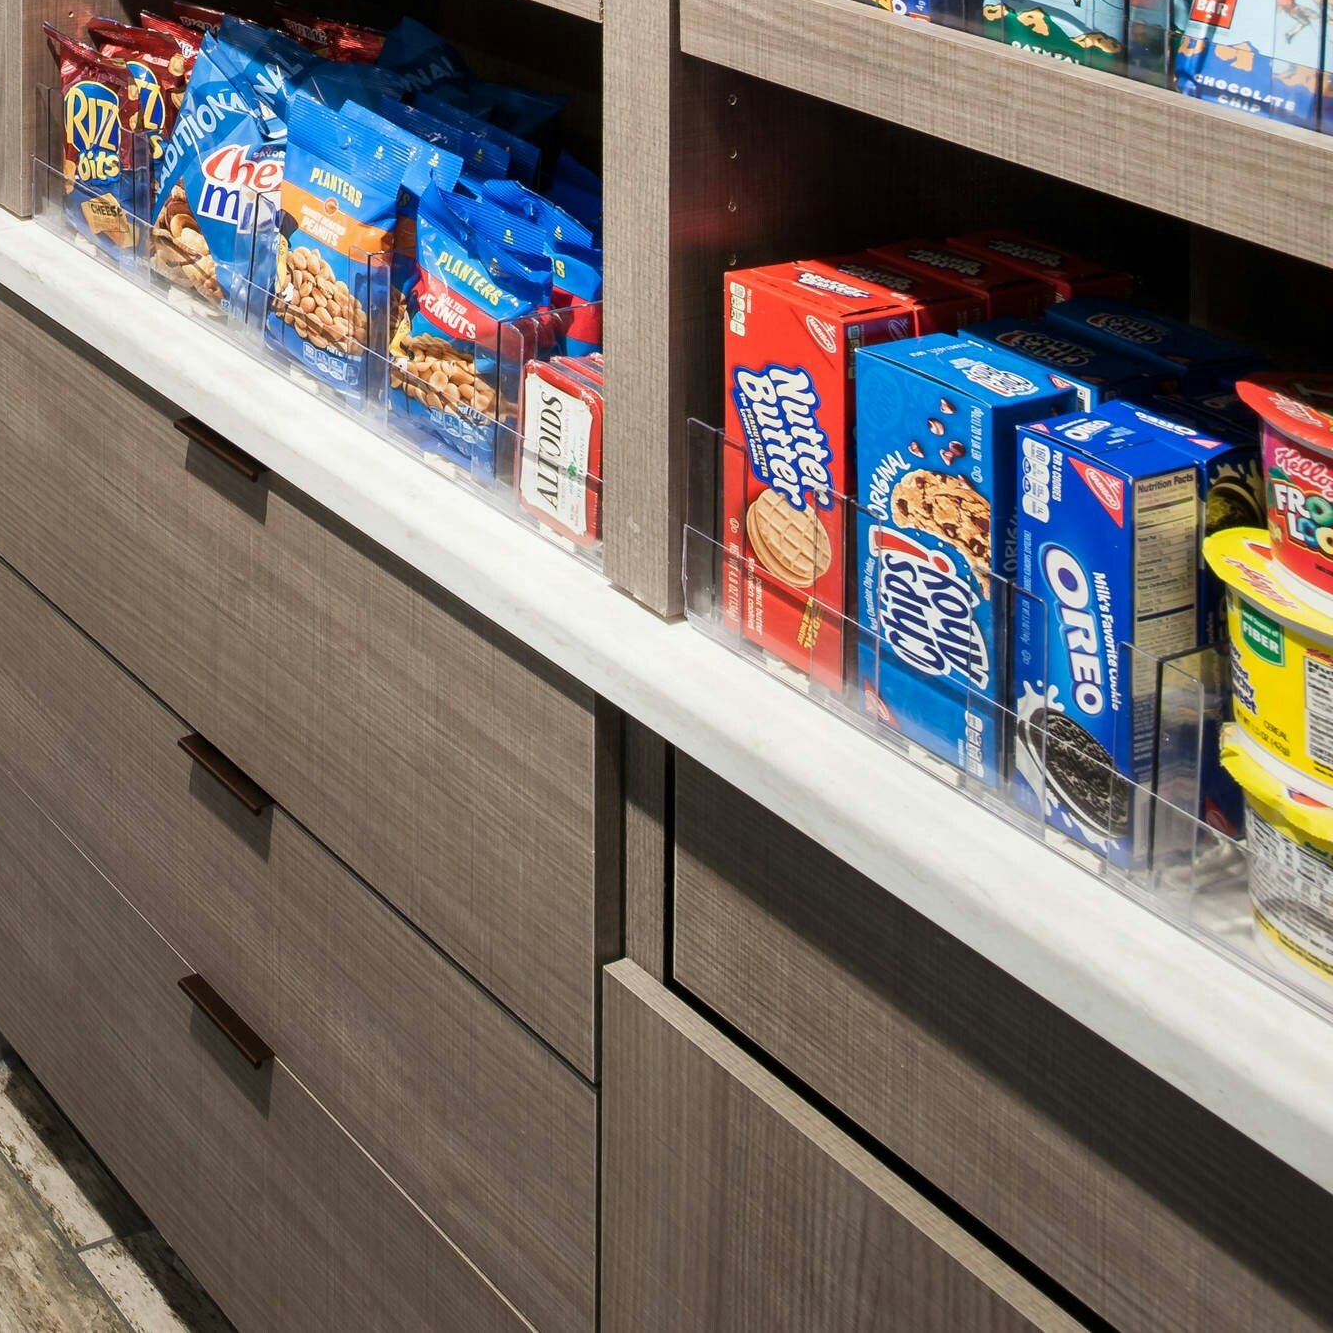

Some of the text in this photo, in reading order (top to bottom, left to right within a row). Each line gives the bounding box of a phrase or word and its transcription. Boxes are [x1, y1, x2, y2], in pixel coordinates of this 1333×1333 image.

[1194, 73, 1296, 112] CHOCOLATE
[1217, 94, 1262, 113] CHIP
[64, 86, 121, 151] RITZ
[77, 152, 121, 182] bits
[252, 151, 286, 160] SAVOR
[309, 167, 363, 209] PLANTERS
[300, 216, 340, 248] PEANUTS
[435, 251, 504, 307] PLANTERS
[418, 296, 478, 340] PEANUTS
[809, 317, 835, 351] NABISCO
[536, 390, 564, 511] ALTOIDS
[737, 370, 802, 507] Butter
[768, 368, 832, 507] Nutter
[867, 448, 911, 521] ORIGINAL
[1088, 470, 1119, 508] NABISCO
[1137, 473, 1194, 495] Nutrition Facts
[880, 552, 947, 676] Chips
[1041, 542, 1105, 716] OREO
[1092, 570, 1108, 611] Milk's
[1100, 610, 1119, 668] Favorite
[1242, 620, 1282, 656] FIBER
